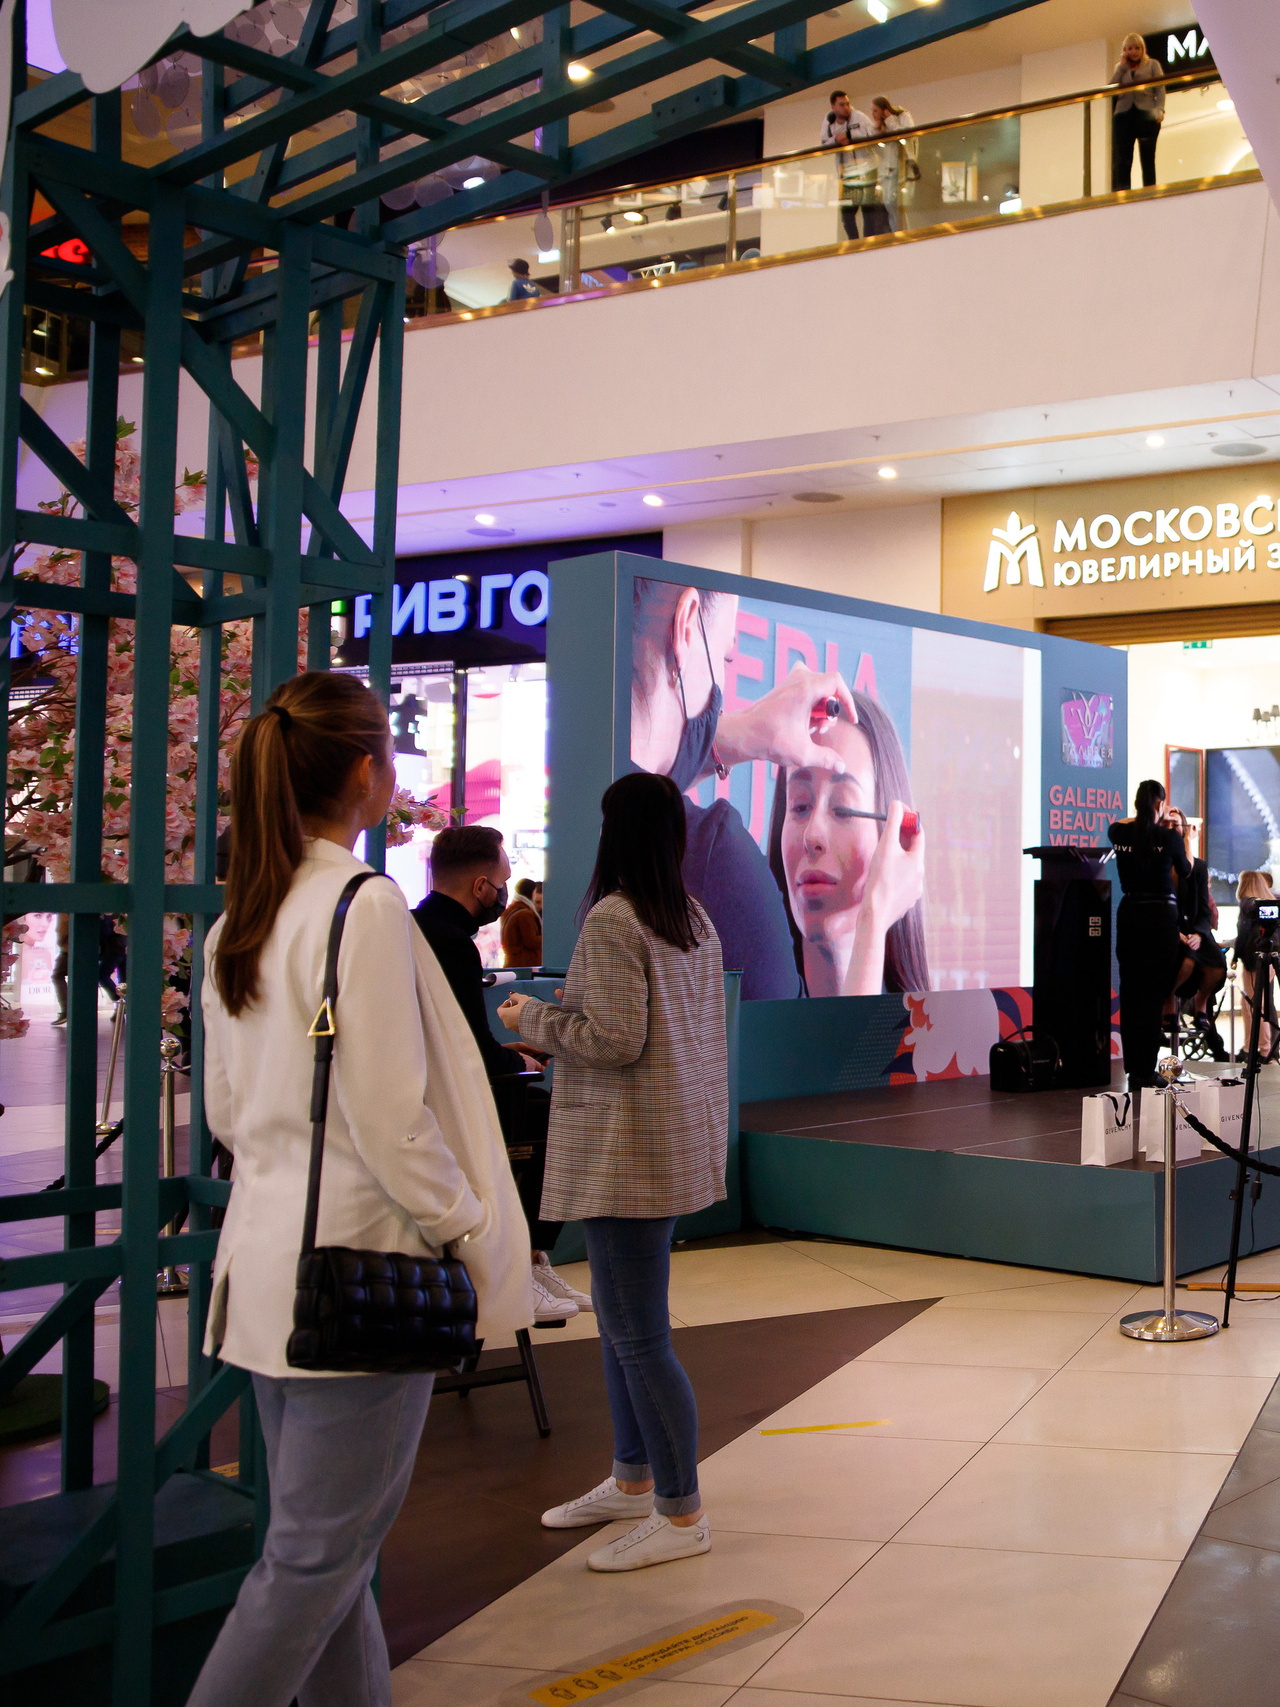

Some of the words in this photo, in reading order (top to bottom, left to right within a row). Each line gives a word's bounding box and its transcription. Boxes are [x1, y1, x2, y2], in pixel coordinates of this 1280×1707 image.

[1052, 538, 1256, 587] ЮВЕЛИРНЫЙ
[1049, 785, 1123, 810] GALERIA
[1049, 809, 1117, 832] BEAUTY
[28, 985, 52, 995] DIOR
[1105, 1123, 1132, 1135] GIVENCHY
